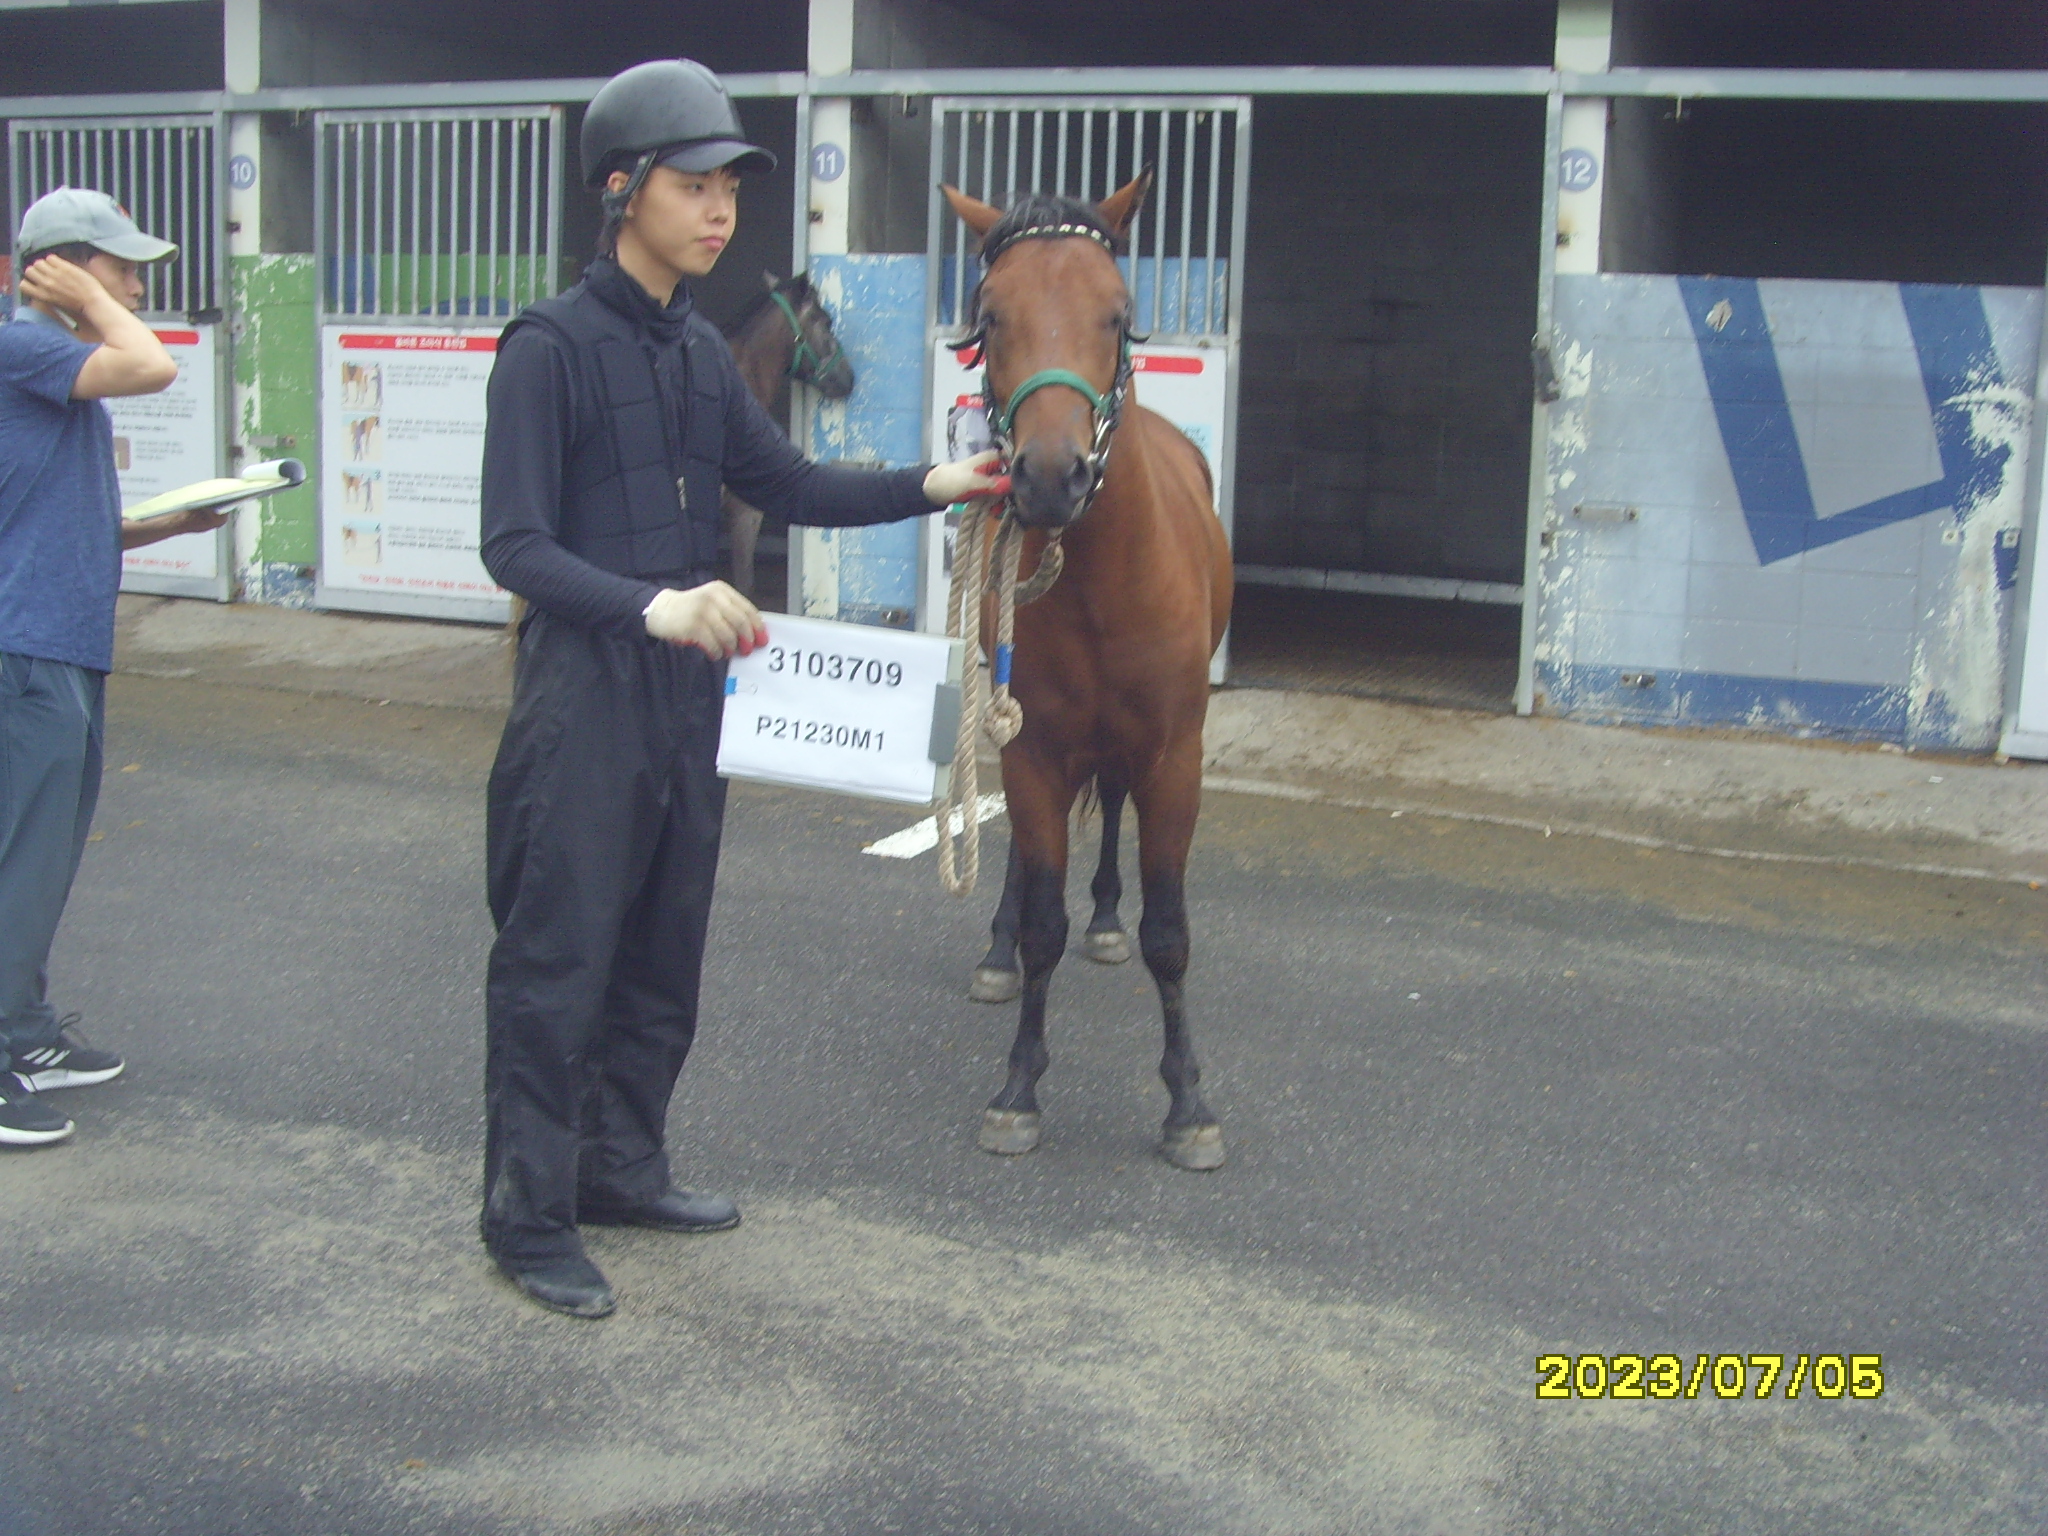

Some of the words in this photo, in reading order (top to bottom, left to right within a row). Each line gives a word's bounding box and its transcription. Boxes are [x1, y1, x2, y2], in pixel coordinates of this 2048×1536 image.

[231, 161, 252, 183] 10
[815, 150, 836, 175] 11
[1562, 157, 1592, 184] 12
[768, 647, 903, 687] 3103709
[756, 714, 887, 752] P21230M1
